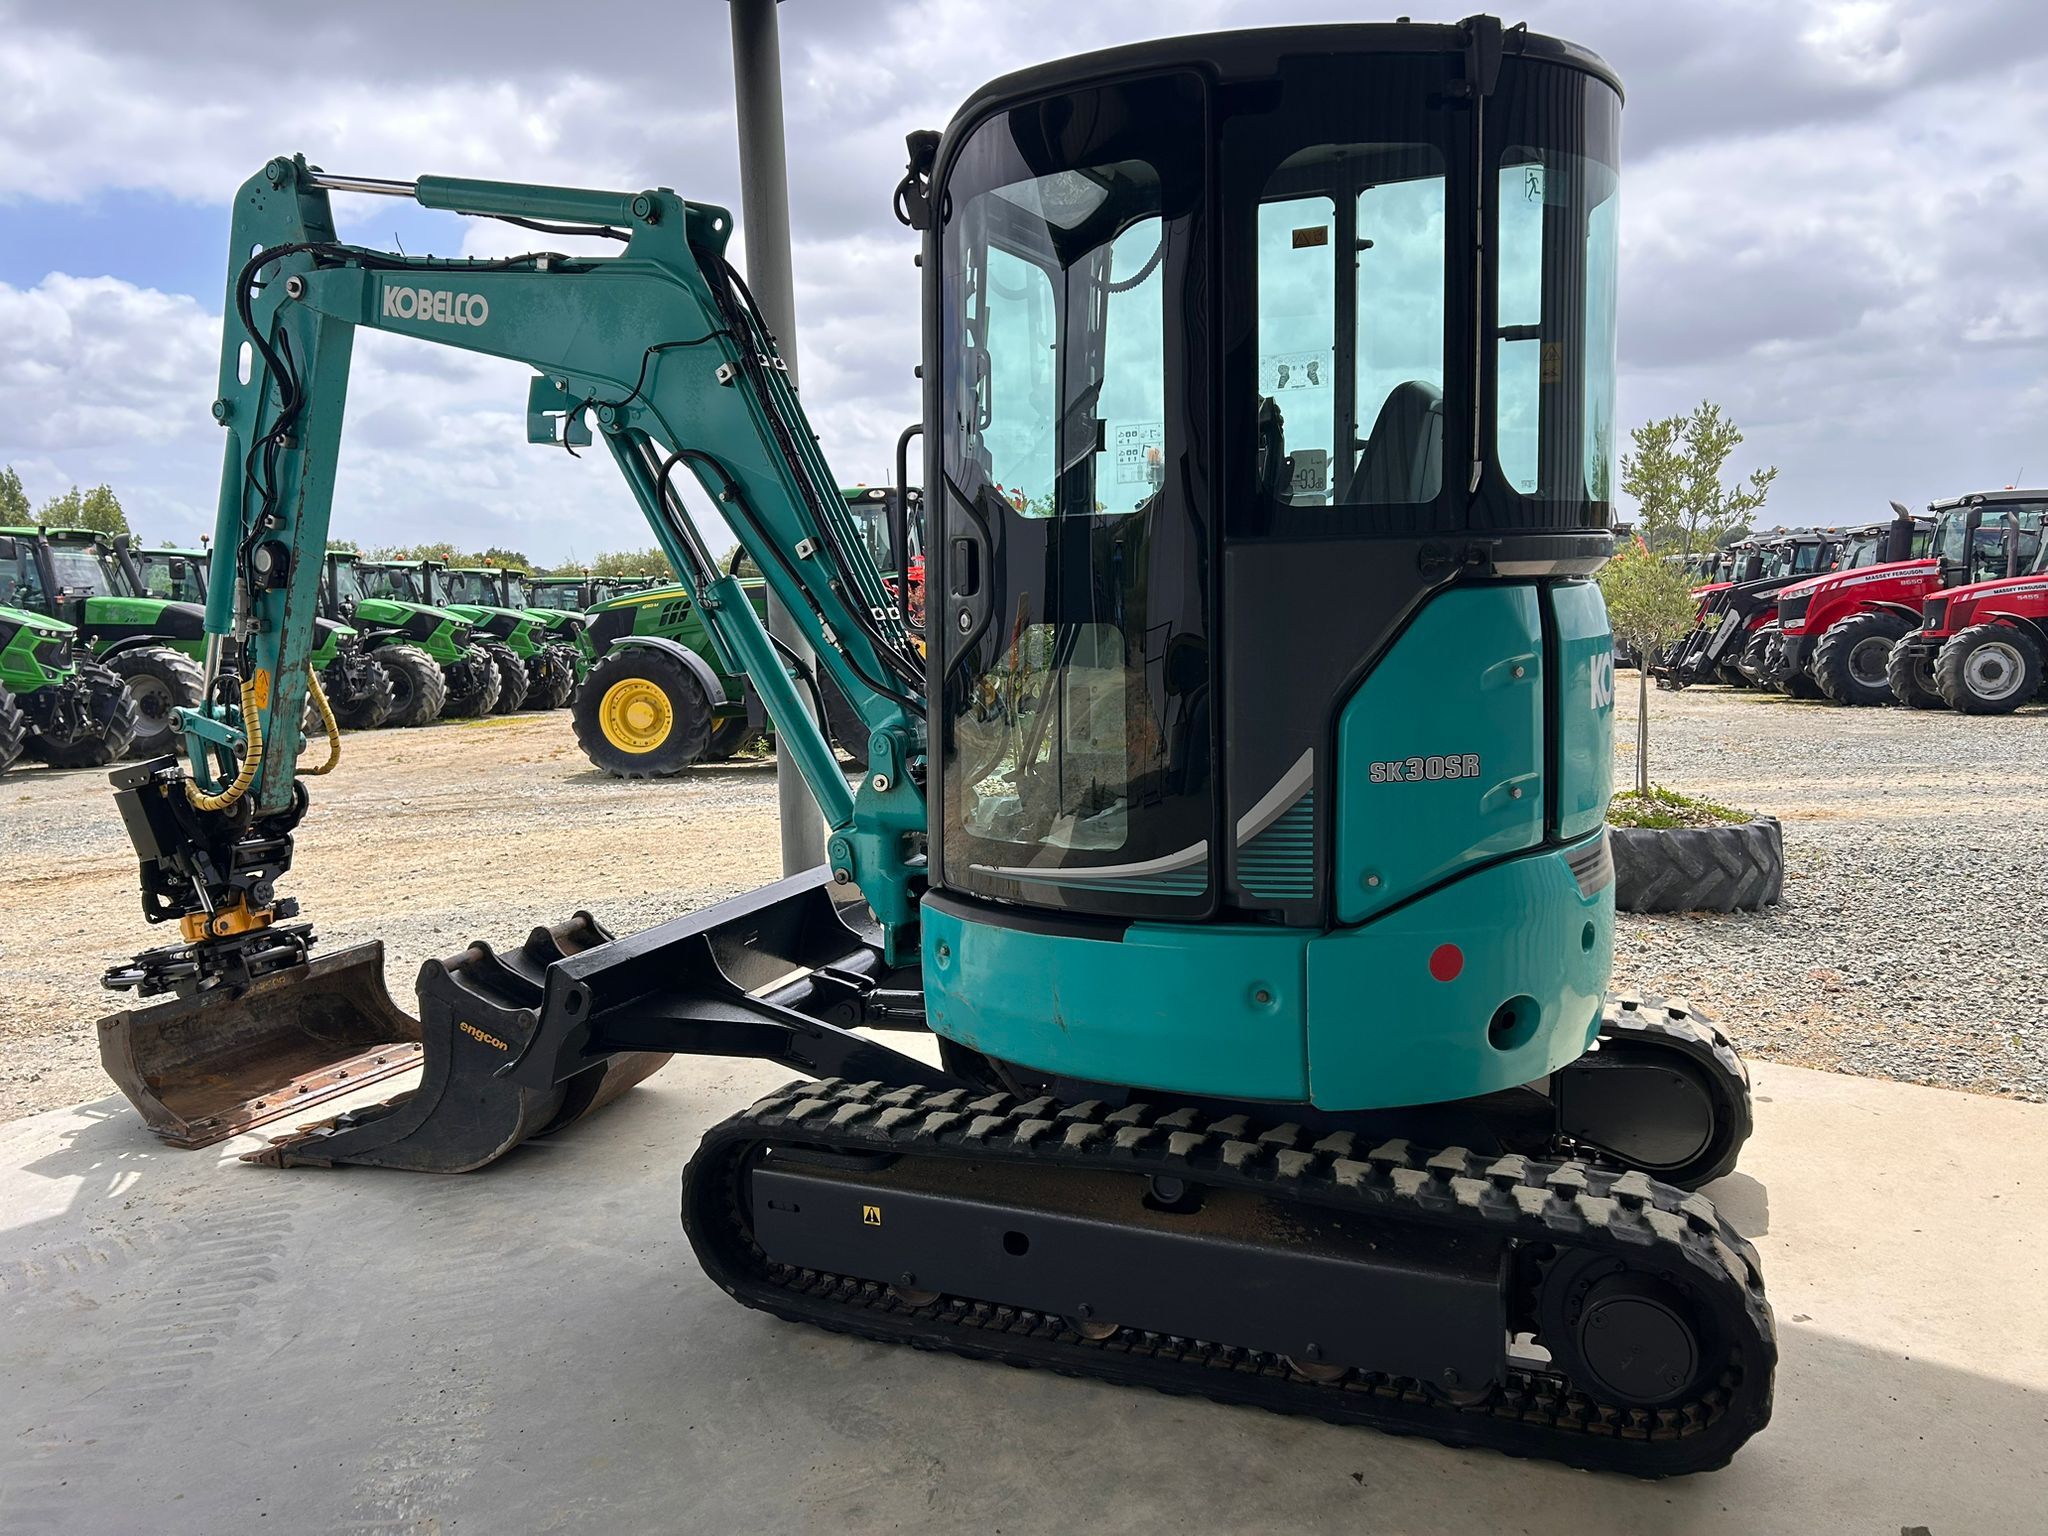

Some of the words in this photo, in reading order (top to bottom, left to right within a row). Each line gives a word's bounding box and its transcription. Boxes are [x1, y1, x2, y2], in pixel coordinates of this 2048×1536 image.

[383, 285, 489, 326] KOBELCO
[1865, 573, 1890, 581] MASSEY
[1892, 569, 1924, 577] FERGUSON
[1591, 650, 1614, 709] KO
[1369, 753, 1480, 783] SK30SR
[459, 1021, 509, 1051] engcon
